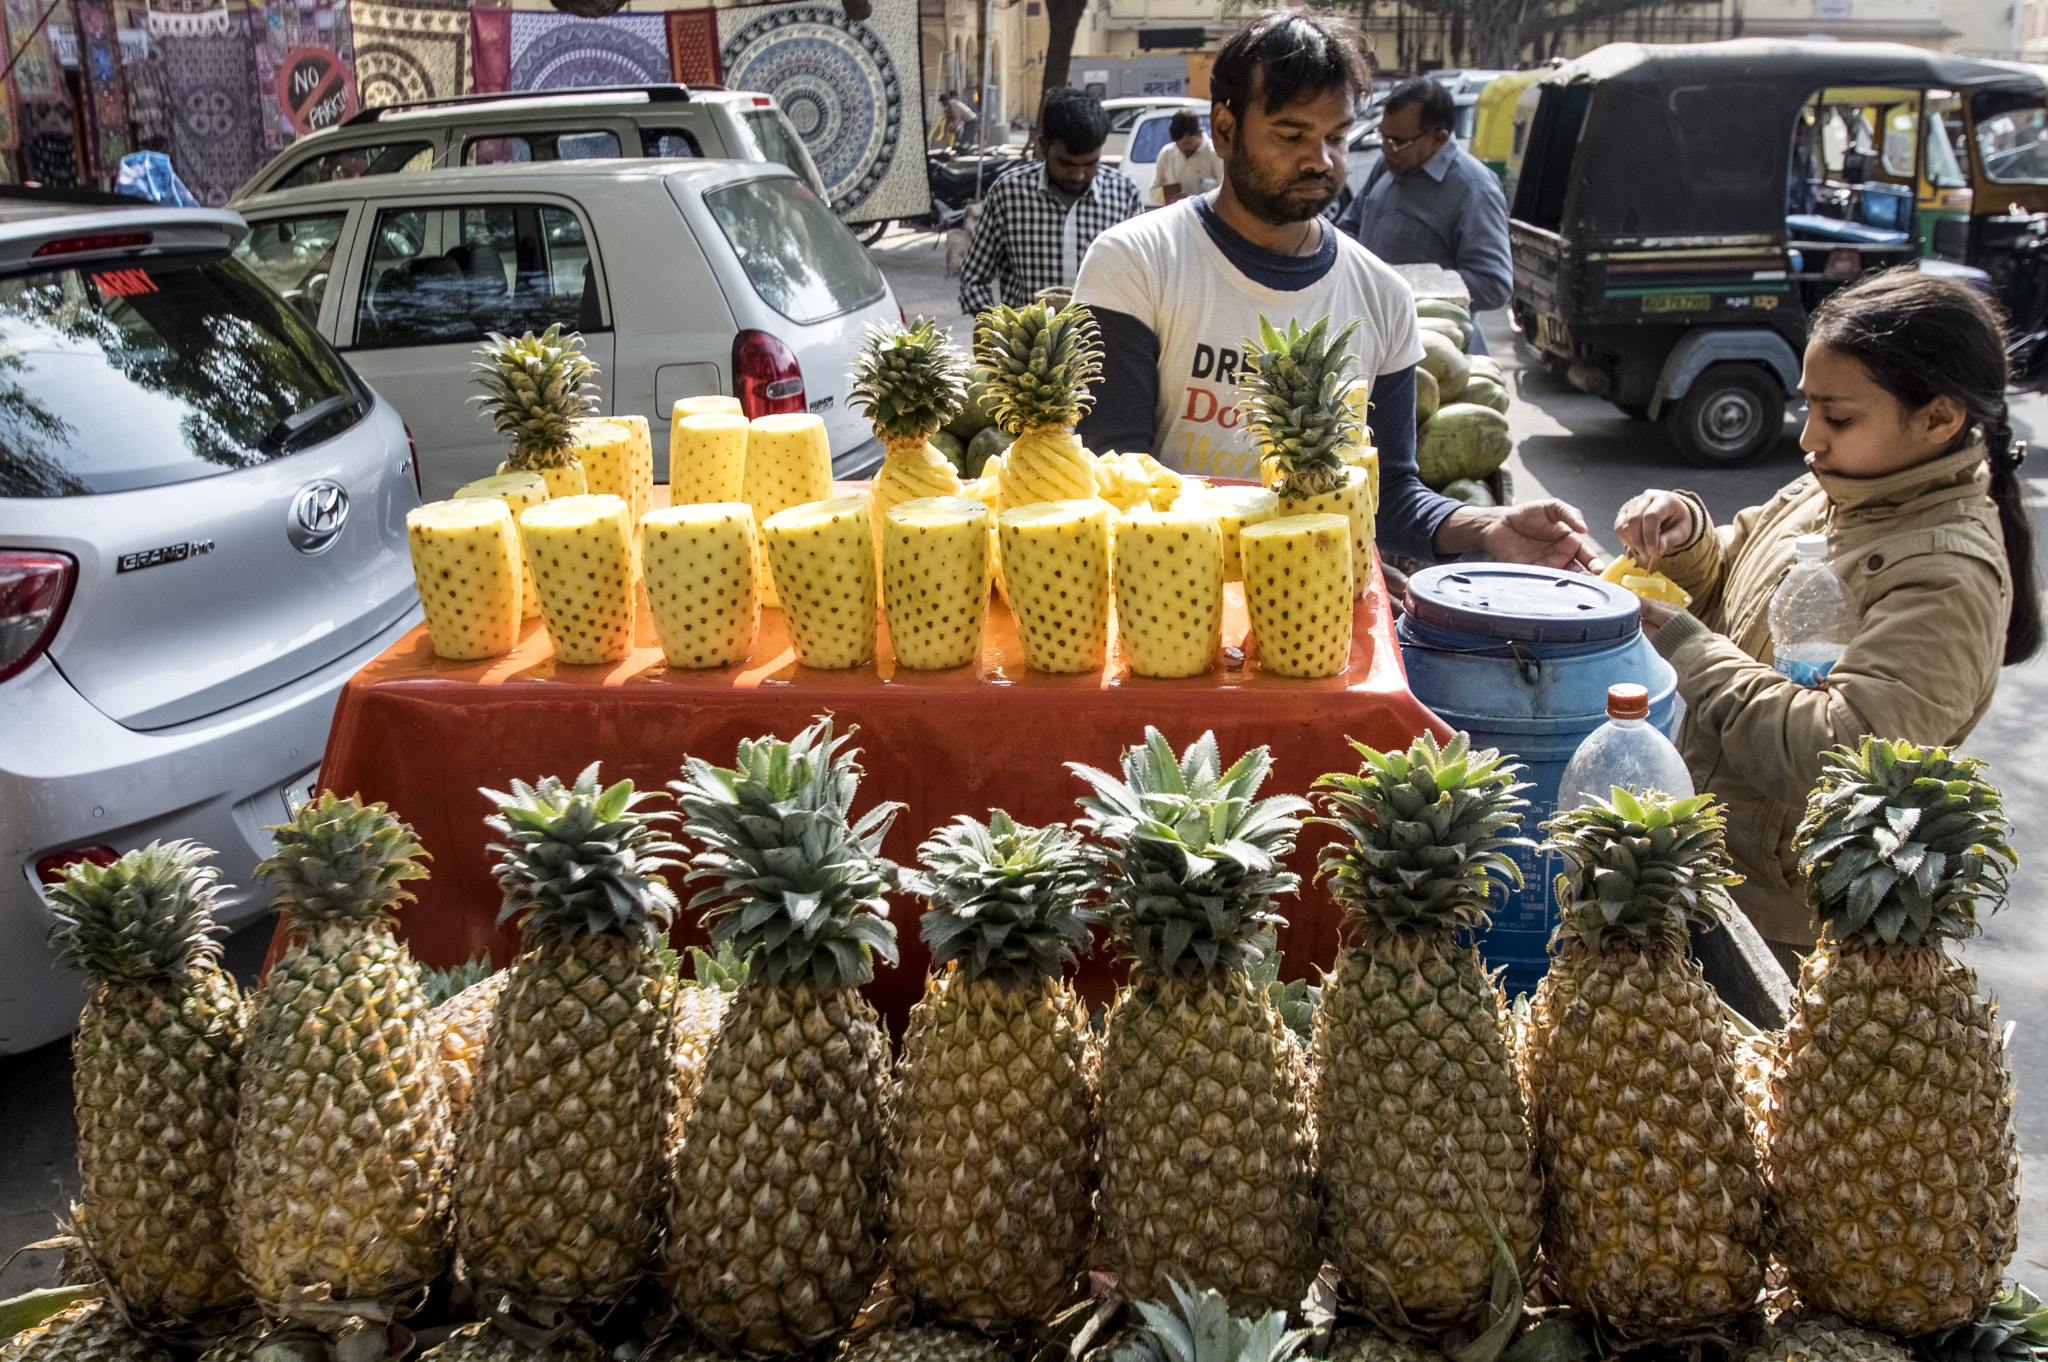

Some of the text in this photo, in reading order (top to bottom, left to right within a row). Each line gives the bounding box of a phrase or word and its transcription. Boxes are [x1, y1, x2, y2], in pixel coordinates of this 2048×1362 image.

[295, 66, 319, 95] NO
[91, 268, 159, 297] ARMY
[1191, 343, 1259, 386] DRE
[1181, 387, 1262, 433] Do
[123, 544, 187, 570] GRAND
